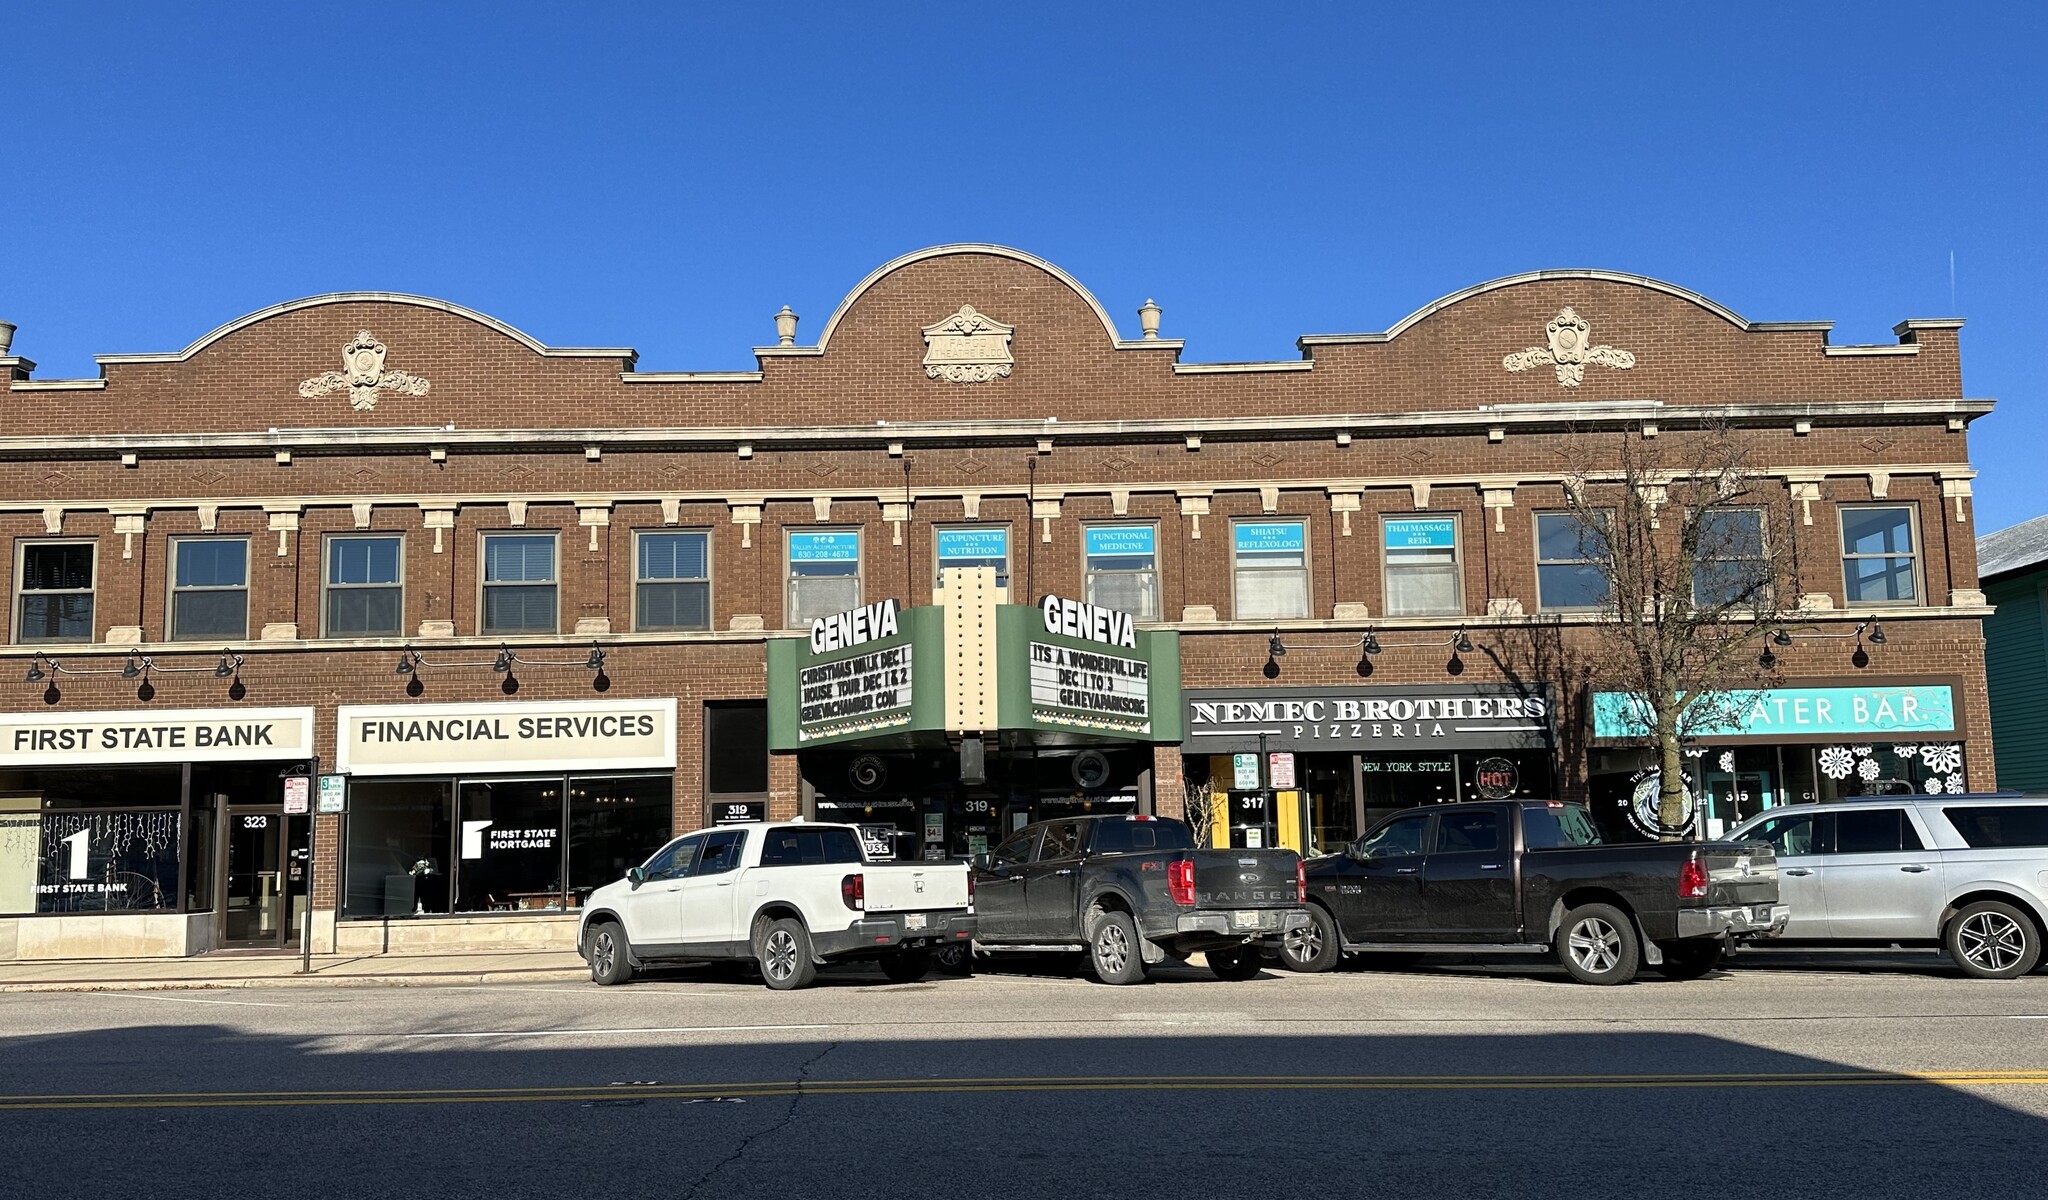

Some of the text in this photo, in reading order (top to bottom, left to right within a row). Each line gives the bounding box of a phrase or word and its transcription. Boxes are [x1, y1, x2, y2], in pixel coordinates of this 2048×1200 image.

[1250, 527, 1287, 536] SHIATSU
[1386, 523, 1452, 533] THAI MASSAGE
[940, 534, 1004, 542] ACUPUNCTURE
[1092, 532, 1150, 541] FUNCTIONAL
[1407, 536, 1432, 545] REIKI
[947, 546, 998, 555] NUTRITION
[1099, 542, 1144, 550] MEDICINE
[1238, 540, 1301, 549] REFLEXOLOGY
[811, 598, 898, 655] GENEVA
[1043, 594, 1136, 649] GENEVA
[801, 660, 852, 686] CHRISTMAS
[852, 653, 879, 676] WALK
[880, 649, 899, 668] DEC
[1033, 644, 1147, 679] ITS A WONDERFUL LIFE
[804, 683, 833, 704] HOUSE
[837, 678, 860, 697] TOUR
[863, 672, 882, 693] DEC
[891, 669, 899, 686] &
[900, 667, 907, 684] 2
[1058, 668, 1079, 687] DEC
[1090, 673, 1104, 691] TO
[1107, 676, 1114, 692] 3
[801, 689, 898, 722] GENEVACHAMBER COM
[1190, 697, 1547, 724] NEMEC BROTHERS
[1852, 696, 1921, 724] BAR
[361, 715, 655, 743] FINANCIAL SERVICES
[1293, 723, 1445, 738] PIZZERIA
[14, 724, 273, 751] FIRST STATE BANK
[1361, 762, 1452, 772] NEW YORK STYLE
[1480, 771, 1513, 788] HOT
[1629, 769, 1646, 783] THE
[965, 800, 988, 812] 319
[1242, 797, 1264, 809] 317
[1617, 799, 1628, 807] 20
[728, 804, 748, 815] 319
[244, 815, 267, 829] 323
[490, 828, 557, 839] FIRST STATE
[490, 839, 551, 849] MORTGAGE
[30, 882, 128, 894] FIRST STATE BANK
